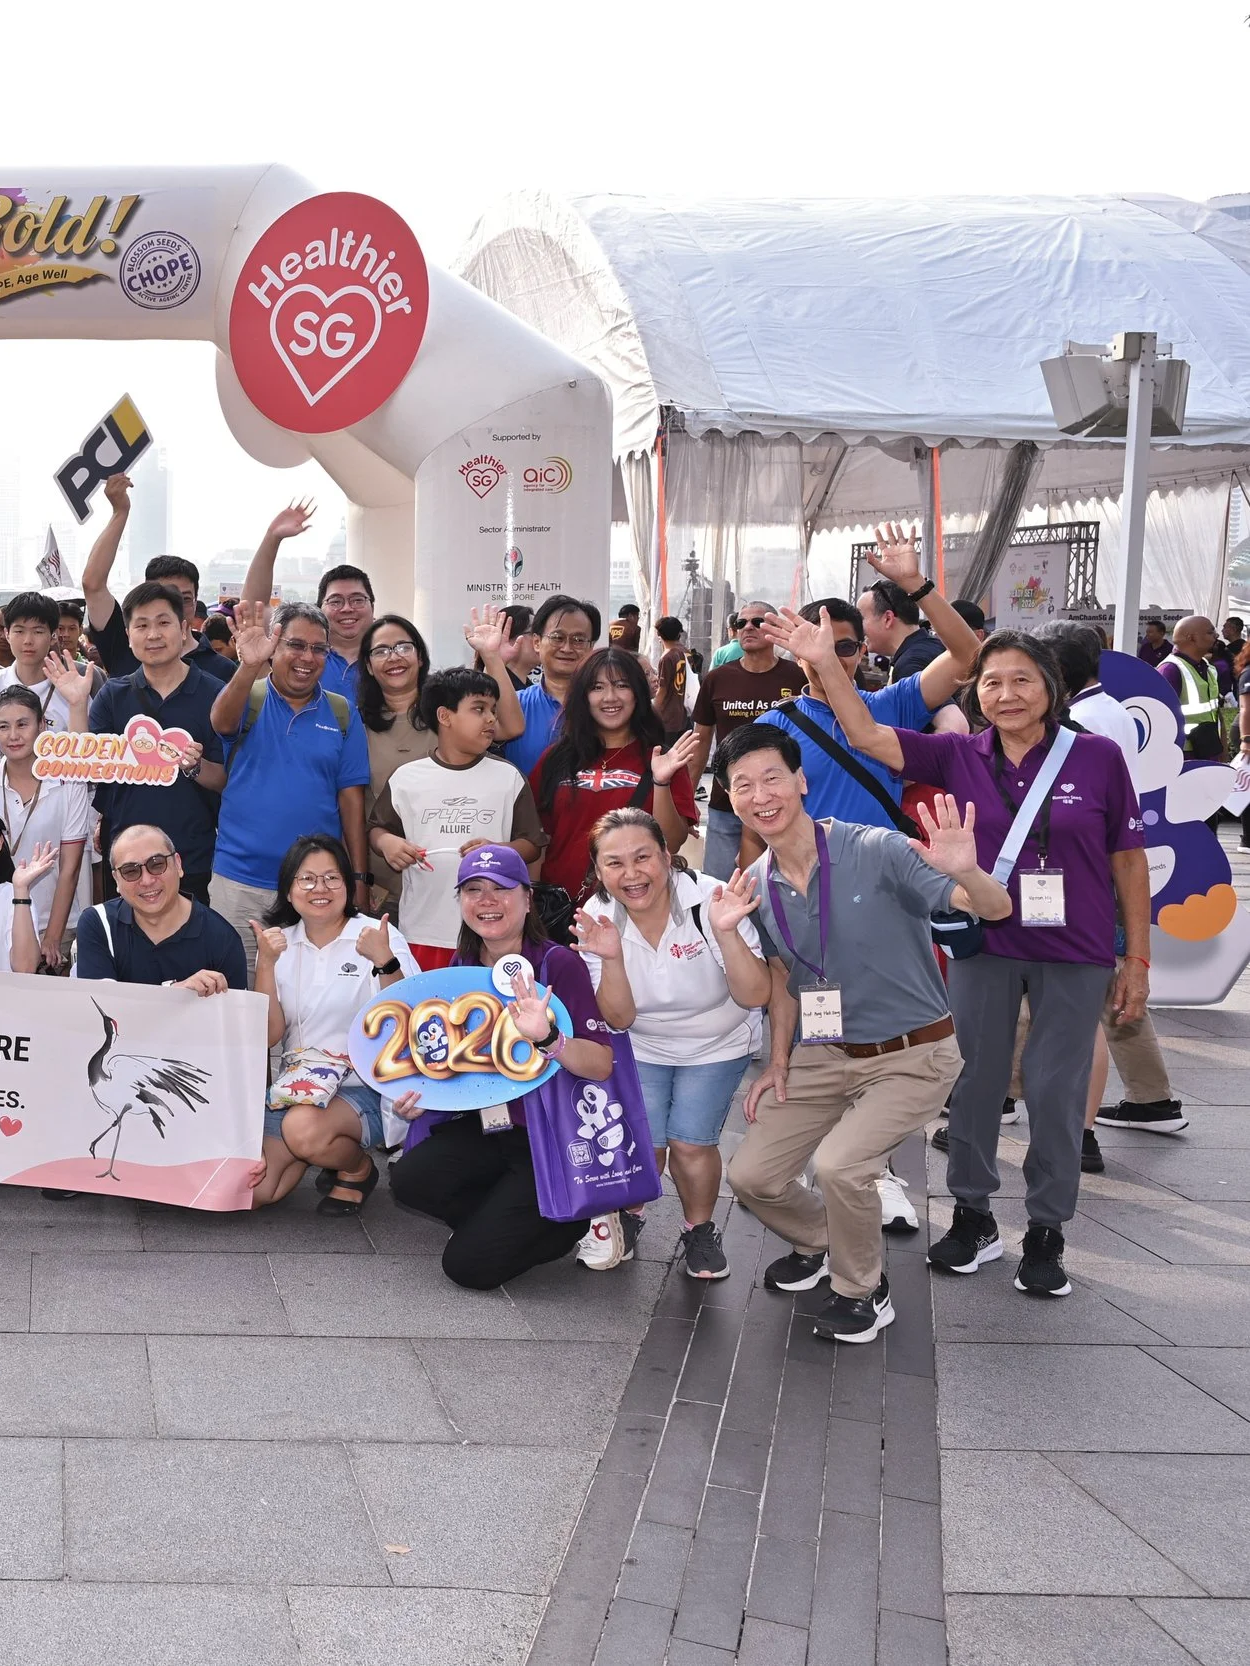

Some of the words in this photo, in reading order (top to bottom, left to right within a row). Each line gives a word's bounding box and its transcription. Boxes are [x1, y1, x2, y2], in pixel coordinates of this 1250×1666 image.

[126, 239, 155, 272] BLOSSOM
[156, 238, 182, 252] SEEDS
[17, 272, 39, 285] Age
[42, 268, 68, 281] Well
[127, 252, 193, 293] CHOPE
[248, 227, 412, 314] Healthier
[137, 291, 157, 303] ACTIVE
[158, 291, 180, 303] AGEING
[180, 272, 193, 296] CENTRE
[289, 311, 356, 358] SG
[492, 433, 531, 442] Supported
[532, 433, 541, 441] by
[458, 454, 508, 476] Healthier
[472, 475, 492, 487] SG
[504, 525, 551, 533] Aministrator
[527, 583, 561, 591] HEALTH
[723, 700, 754, 710] United
[757, 700, 768, 710] As
[37, 734, 129, 761] GOLDEN
[35, 759, 176, 783] CONNECTIONS
[439, 825, 471, 834] ALLURE
[362, 992, 556, 1083] 2026
[573, 1176, 583, 1185] To
[584, 1174, 599, 1183] Serve
[600, 1172, 611, 1180] with
[611, 1169, 623, 1178] Love
[632, 1164, 643, 1174] Care
